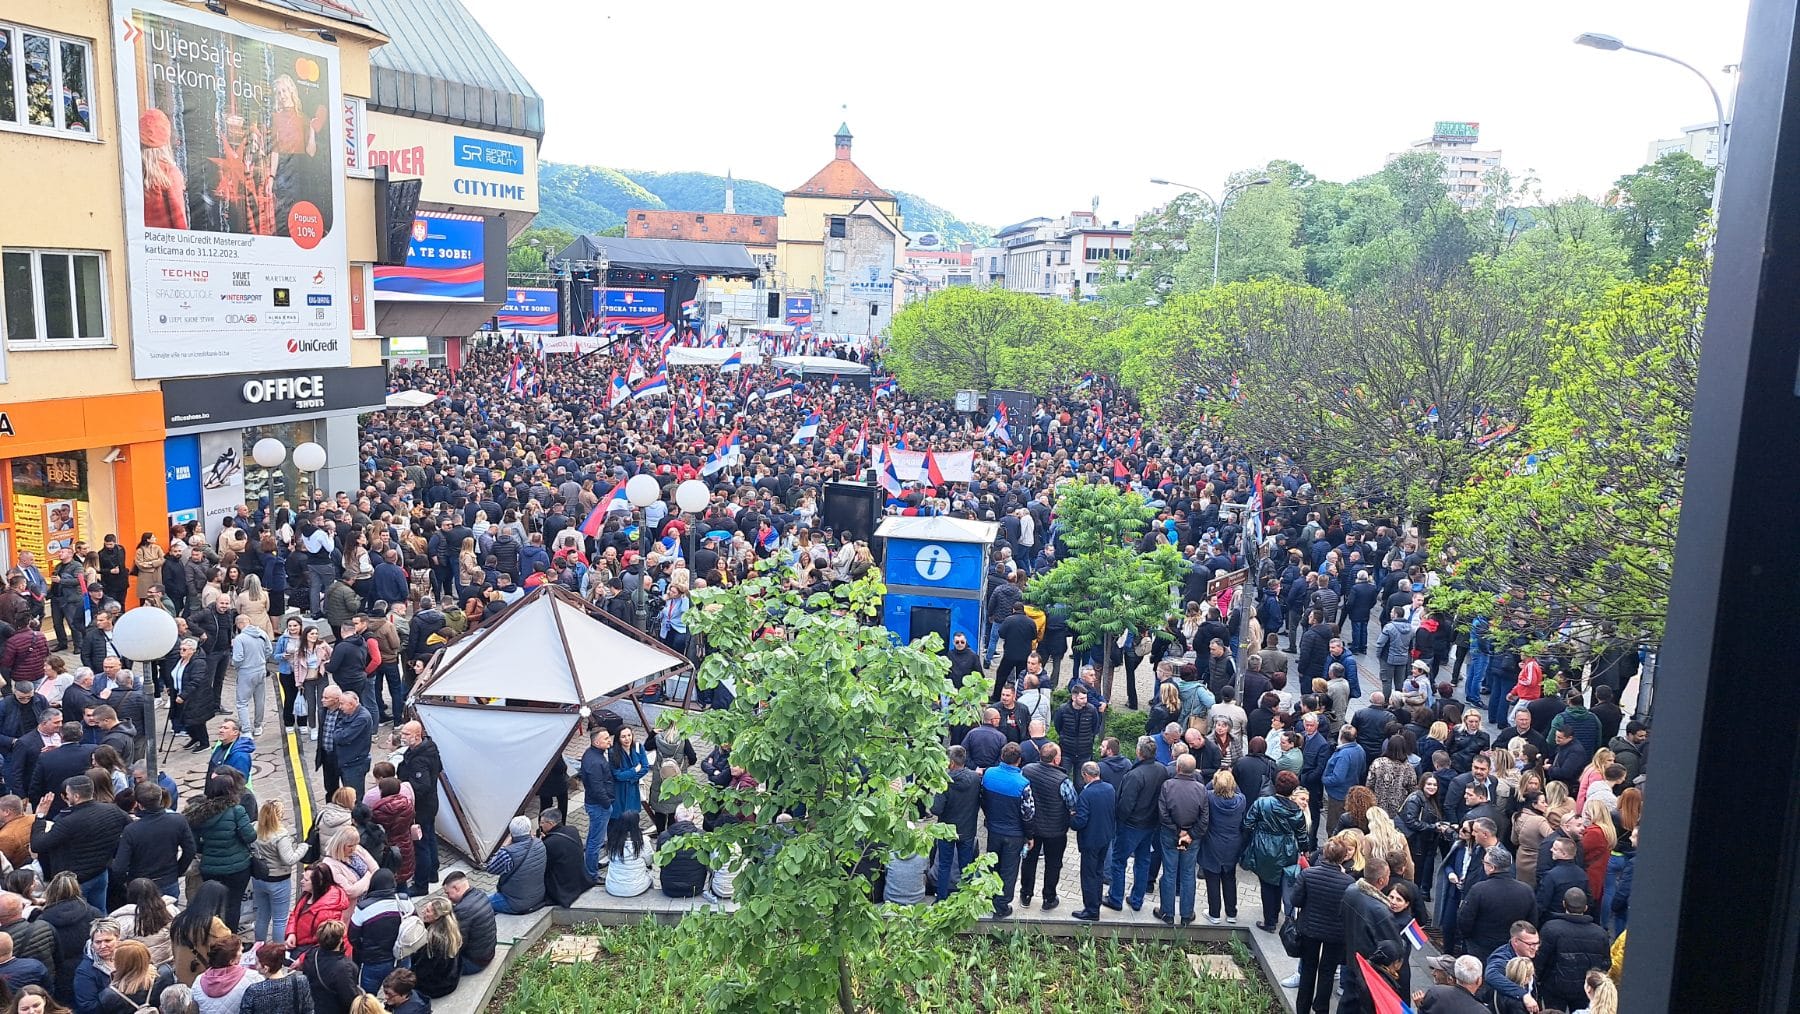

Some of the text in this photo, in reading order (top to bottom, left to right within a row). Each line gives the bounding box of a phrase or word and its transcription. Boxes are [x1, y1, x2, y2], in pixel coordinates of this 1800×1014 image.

[149, 28, 242, 69] Uljepšajte
[153, 62, 226, 91] nekome
[347, 104, 355, 168] RE/MAX
[367, 134, 424, 176] ORKER
[461, 144, 483, 162] SR
[485, 147, 512, 158] SPORT
[485, 155, 518, 167] REALITY
[453, 178, 526, 200] CITYTIME
[294, 212, 317, 223] Popust
[144, 231, 175, 244] Plaćajte
[177, 234, 212, 245] UniCredit
[297, 226, 316, 237] 10%
[144, 244, 184, 256] karticama
[186, 247, 195, 257] do
[420, 247, 435, 257] ТЕ
[438, 248, 471, 259] ЗОВЕ!
[161, 268, 209, 278] TECHNO
[298, 339, 338, 352] UniCredit
[243, 375, 324, 403] OFFICE
[295, 399, 325, 409] SHOES
[206, 506, 232, 517] LACOSTE
